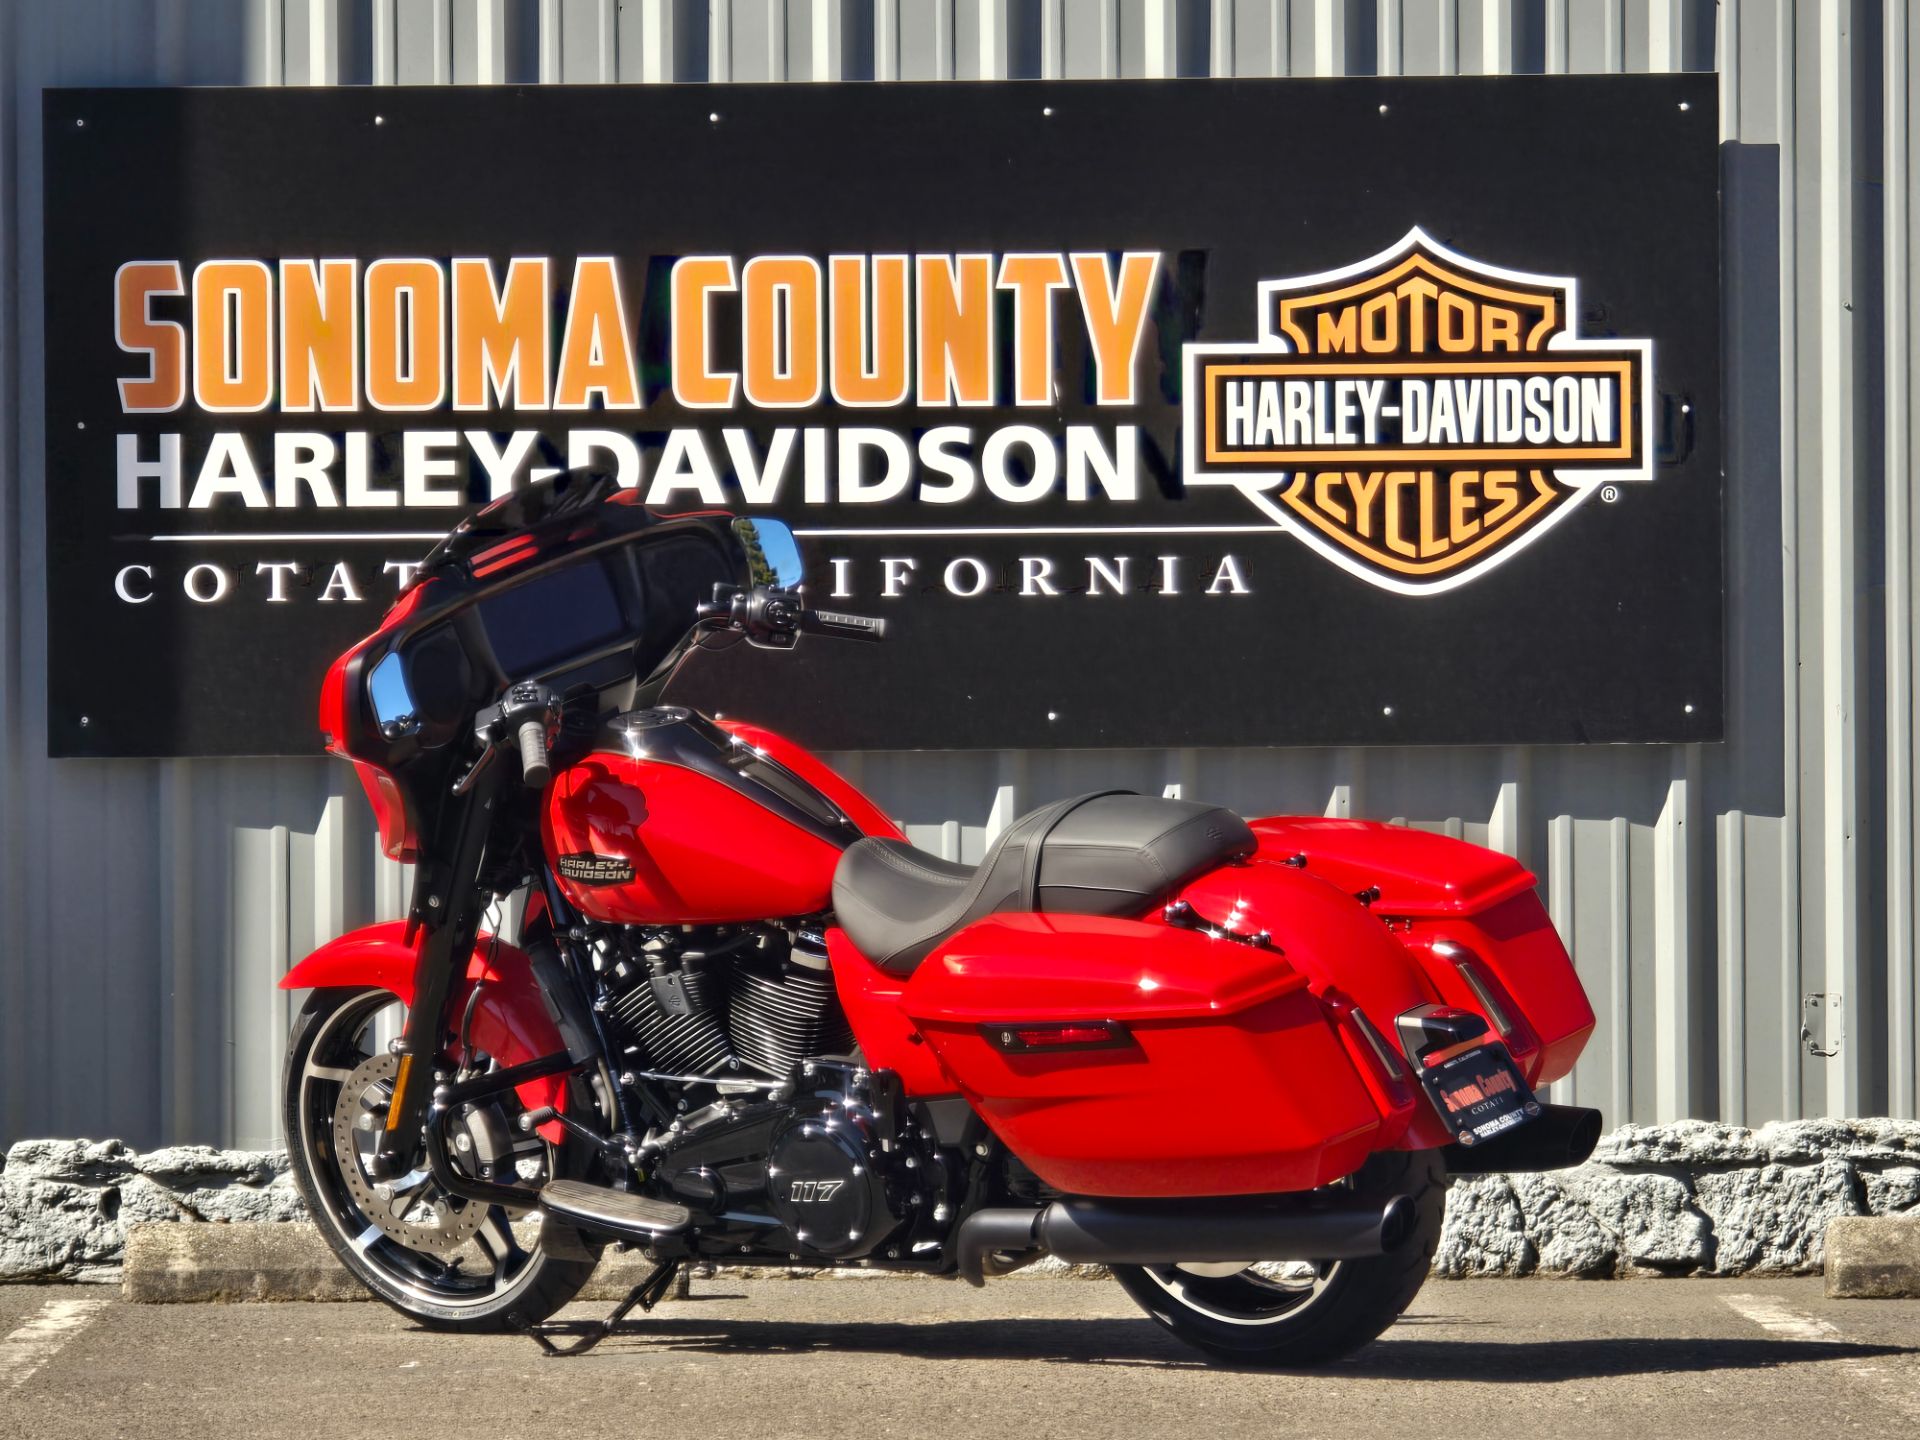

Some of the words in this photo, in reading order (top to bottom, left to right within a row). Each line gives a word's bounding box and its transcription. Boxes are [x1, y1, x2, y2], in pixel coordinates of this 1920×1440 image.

[114, 256, 641, 413] SONOMA
[670, 252, 1161, 409] COUNTY
[1317, 276, 1519, 354] MOTOR
[1225, 375, 1611, 446] HARLEY-DAVIDSON
[116, 425, 1138, 509] HARLEY-DAVIDSON
[1314, 470, 1518, 559] CYCLES
[114, 561, 423, 604] COTAT
[829, 555, 1250, 597] IFORNIA
[559, 857, 624, 870] HARLEY-
[560, 867, 631, 880] DAVIDSON
[1472, 1119, 1500, 1135] SONOMA
[1498, 1108, 1524, 1123] COUNTY
[790, 1179, 845, 1202] 117
